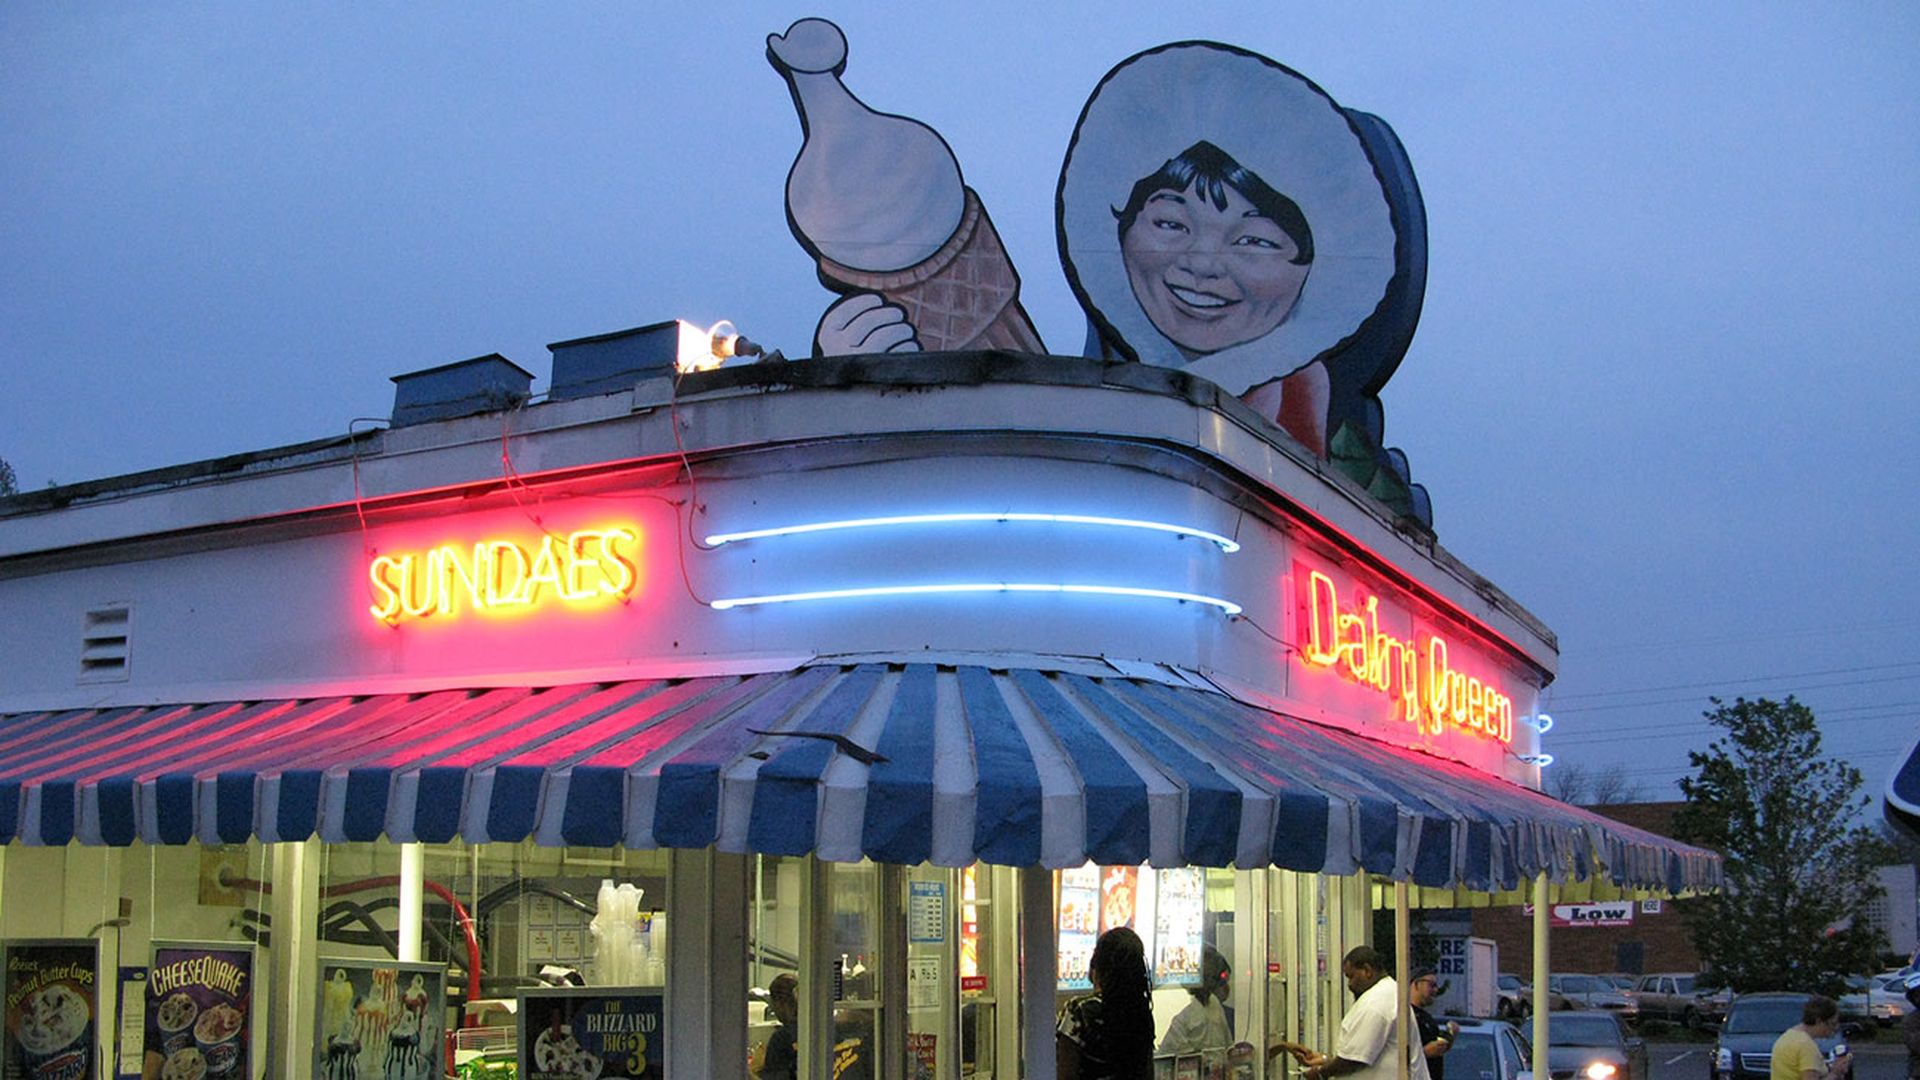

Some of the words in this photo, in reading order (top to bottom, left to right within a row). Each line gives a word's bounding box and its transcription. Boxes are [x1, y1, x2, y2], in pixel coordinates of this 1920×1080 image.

[368, 528, 637, 619] SUNDAES
[1307, 569, 1425, 736] Dairy
[1429, 634, 1512, 743] Queen
[1571, 907, 1626, 920] Low
[70, 961, 94, 985] Cups
[152, 955, 246, 997] CHEESEQUAKE
[586, 1012, 657, 1033] BLIZZARD
[603, 1033, 627, 1053] BIG
[626, 1031, 647, 1076] 3
